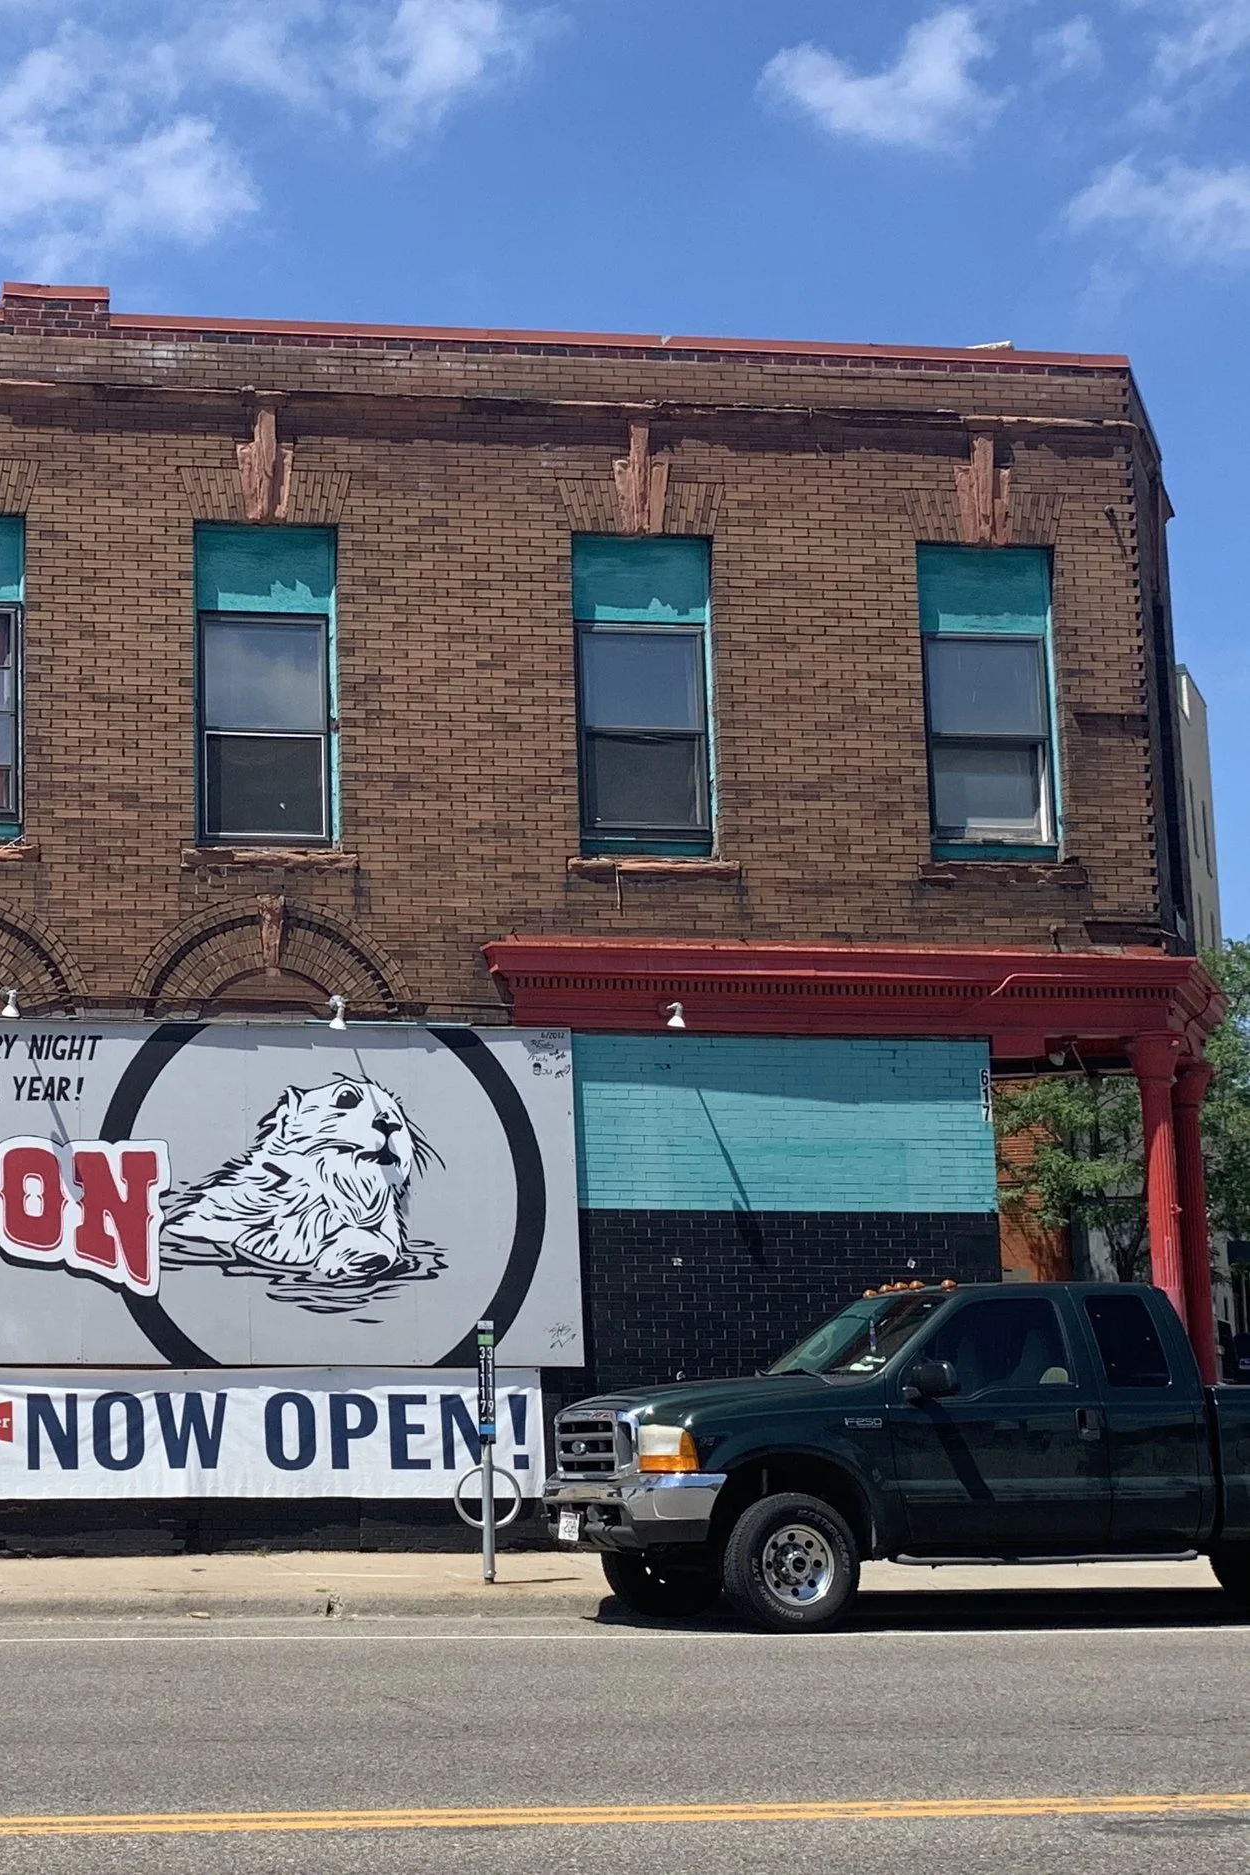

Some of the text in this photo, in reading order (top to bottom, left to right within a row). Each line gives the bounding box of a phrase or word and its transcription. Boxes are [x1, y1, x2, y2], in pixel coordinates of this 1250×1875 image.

[28, 1034, 103, 1061] NIGHT
[13, 1076, 85, 1101] YEAR!
[981, 1069, 990, 1121] 617
[479, 1346, 487, 1413] 31117
[486, 1346, 494, 1413] 31119
[27, 1391, 530, 1471] NOW OPEN!
